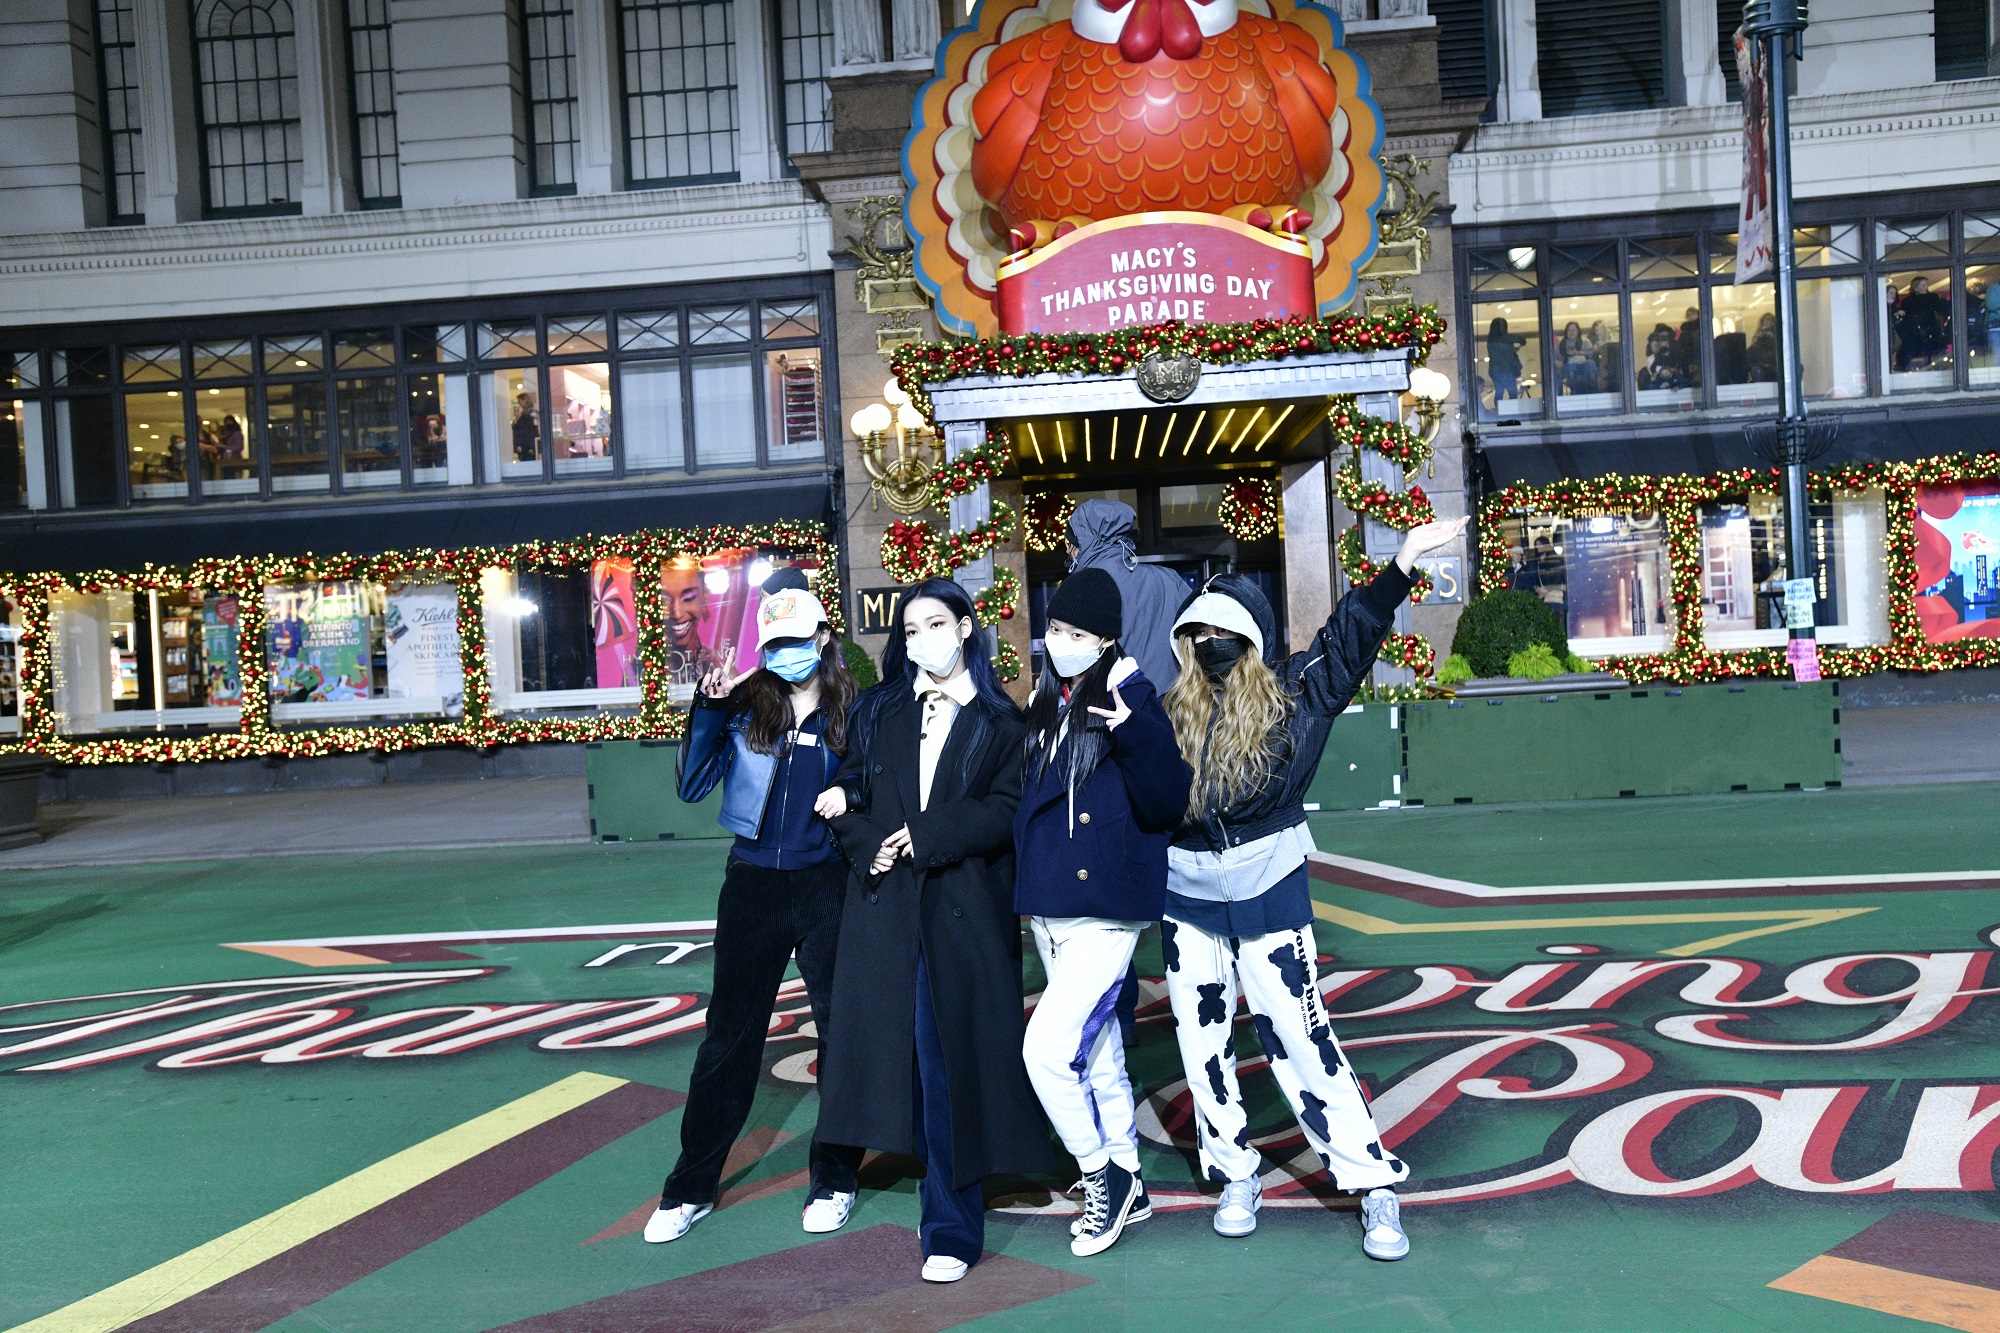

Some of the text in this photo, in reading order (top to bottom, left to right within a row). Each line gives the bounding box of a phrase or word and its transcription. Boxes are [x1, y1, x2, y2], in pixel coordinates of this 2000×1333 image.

[1111, 241, 1197, 273] MACY'S
[1040, 273, 1272, 316] THANKSGIVING DAY
[1108, 300, 1206, 326] PARADE
[1574, 507, 1605, 519] FROM
[1609, 505, 1633, 517] NEW
[308, 620, 353, 632] STEP INTO
[302, 637, 360, 648] DREAMLAND
[420, 633, 455, 642] FINEST
